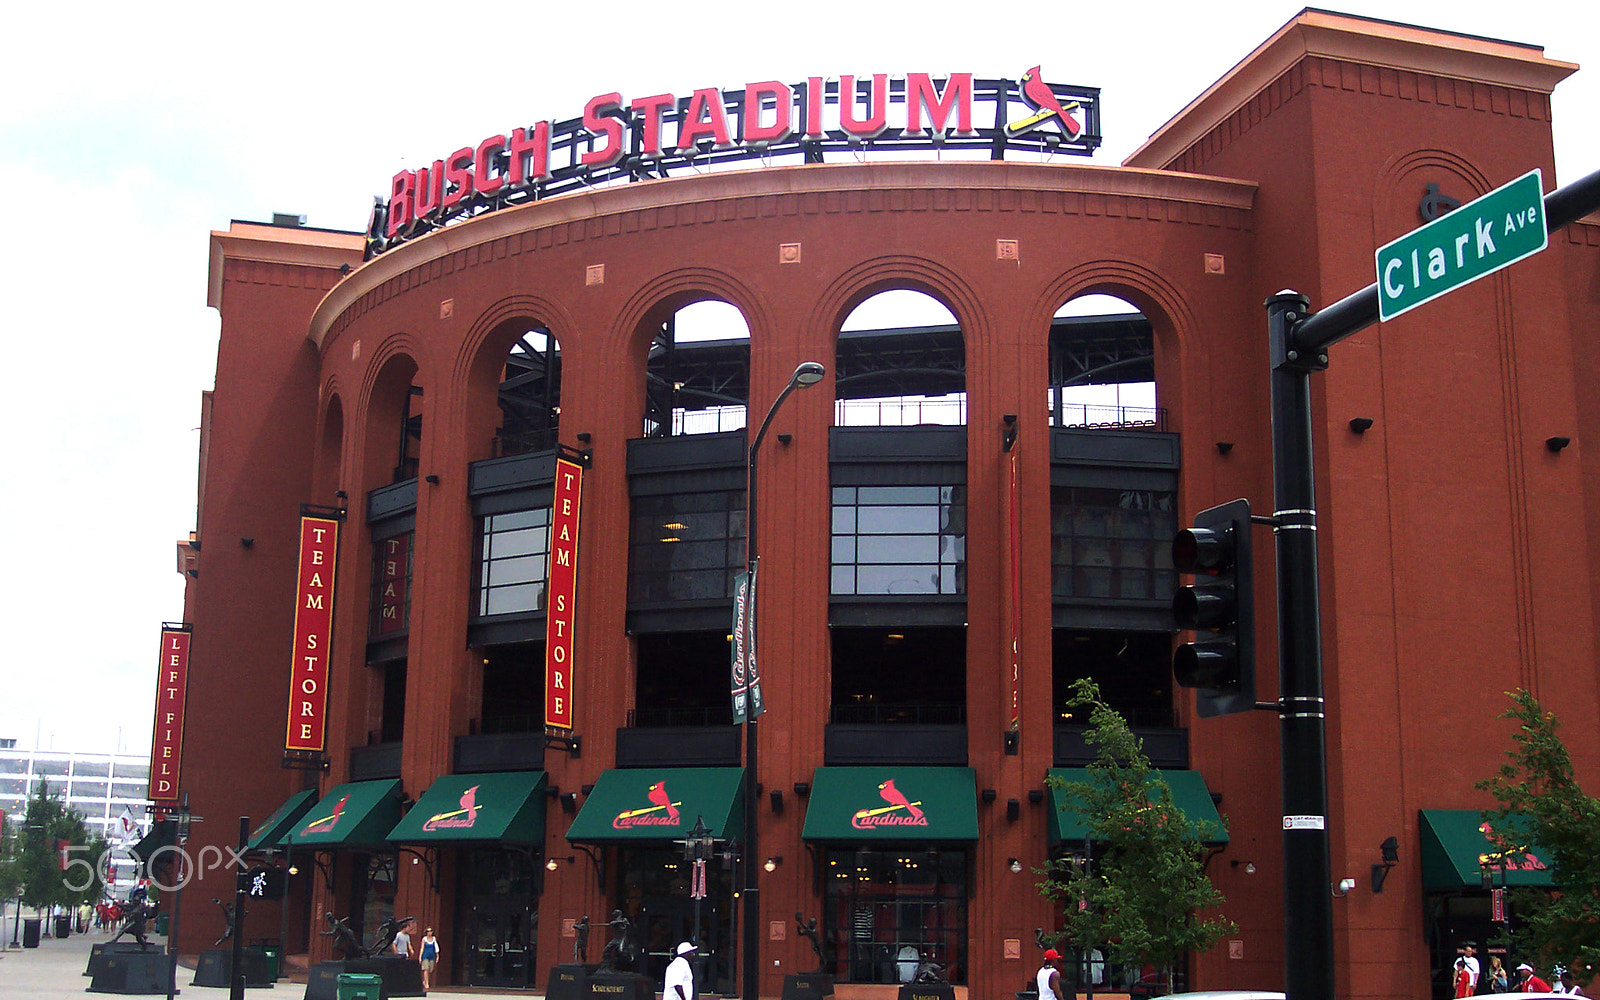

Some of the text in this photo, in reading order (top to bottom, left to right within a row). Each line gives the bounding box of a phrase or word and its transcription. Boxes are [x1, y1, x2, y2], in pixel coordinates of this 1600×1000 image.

[387, 72, 977, 239] BUSCH STADIUM
[1384, 206, 1538, 299] Clark Ave
[300, 528, 326, 739] TEAM STORE
[554, 473, 575, 714] TEAM STORE
[158, 638, 181, 792] LEFT FIELD
[612, 810, 680, 830] Cardinals
[851, 808, 930, 830] Cardinals
